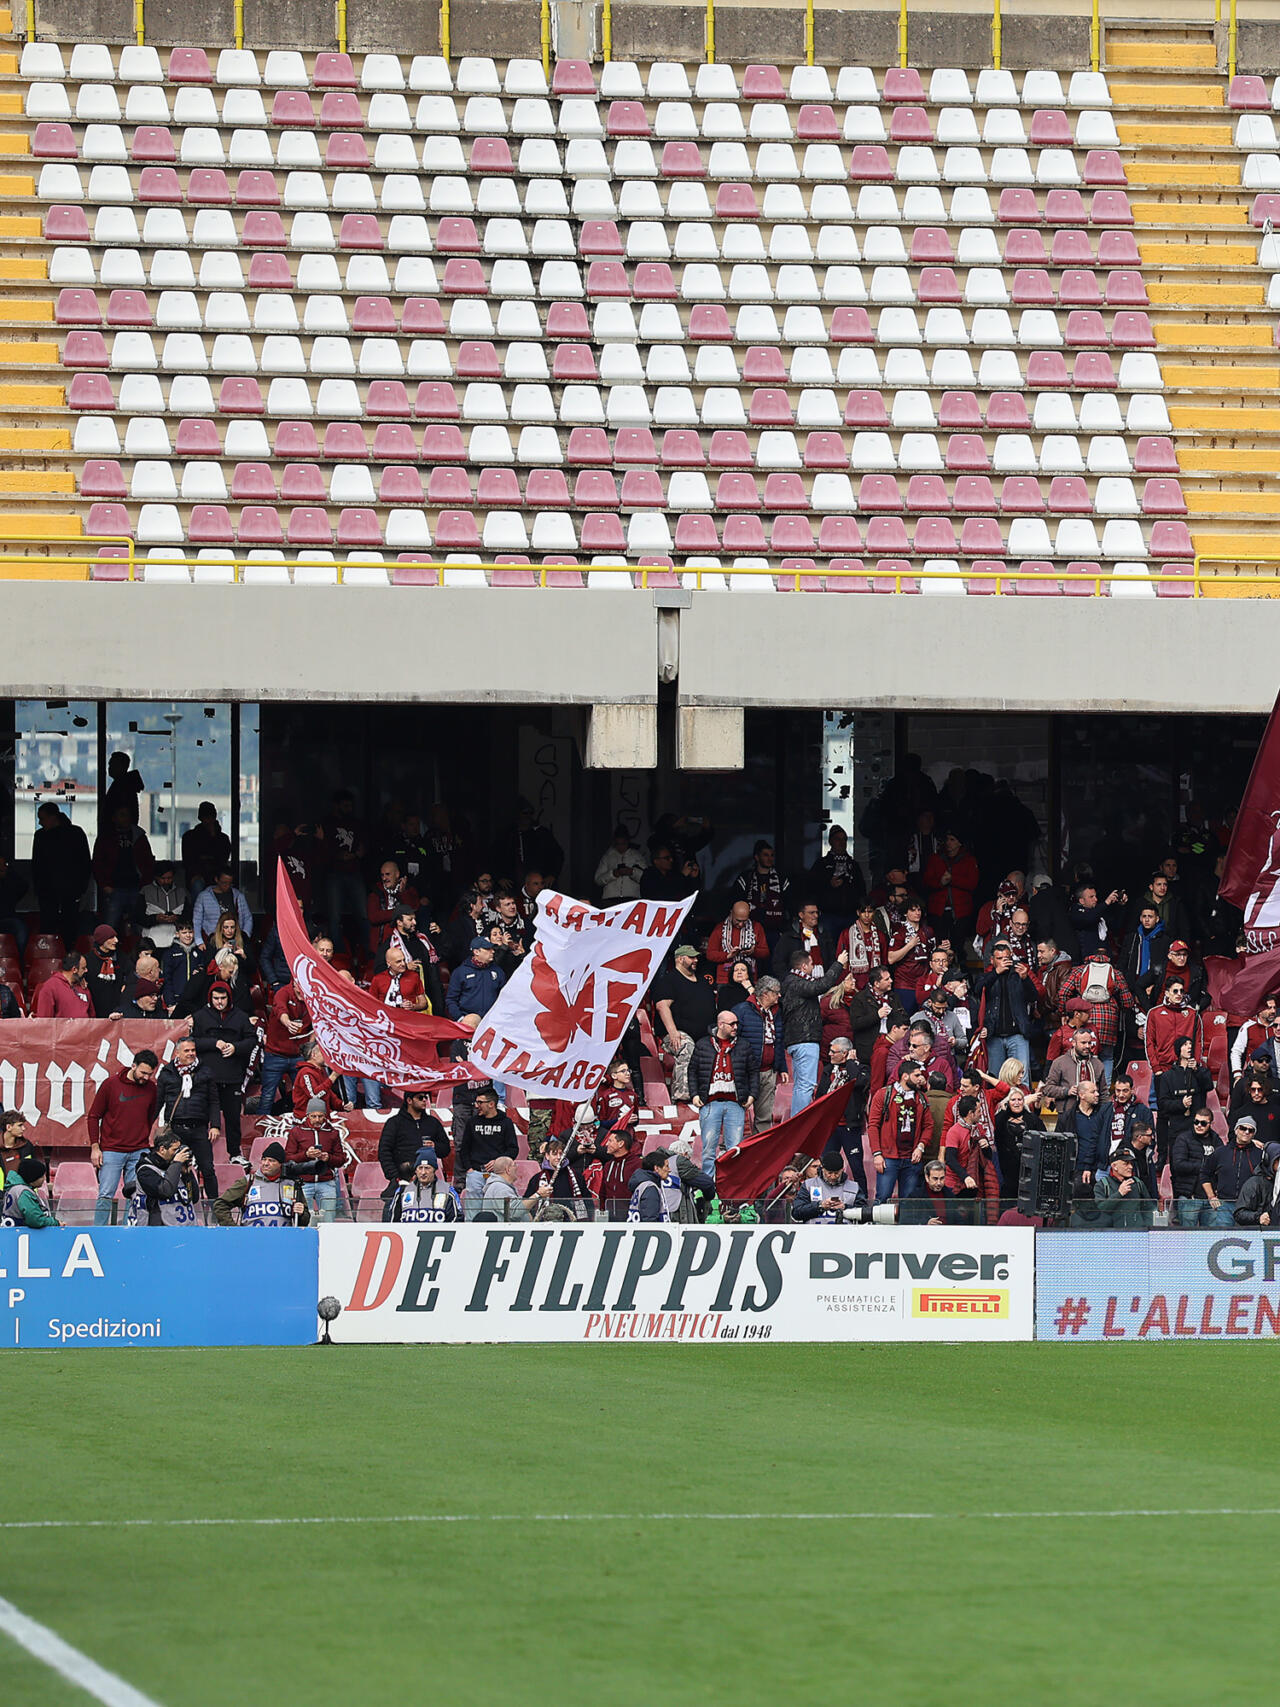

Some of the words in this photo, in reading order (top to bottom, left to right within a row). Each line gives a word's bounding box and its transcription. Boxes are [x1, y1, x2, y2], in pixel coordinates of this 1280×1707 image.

[175, 1205, 195, 1223] 38
[248, 1203, 292, 1217] PHOTO
[0, 1233, 105, 1278] LA
[345, 1229, 456, 1312] DE
[463, 1229, 797, 1313] FILIPPIS
[817, 1294, 885, 1303] PNEUMATICI
[890, 1294, 896, 1303] E
[826, 1304, 896, 1312] ASSISTENZA
[919, 1293, 1001, 1313] PIRELLI
[47, 1318, 161, 1343] Spedizioni
[584, 1313, 721, 1339] PNEUMATICI
[720, 1324, 740, 1339] dal
[742, 1324, 772, 1339] 1948
